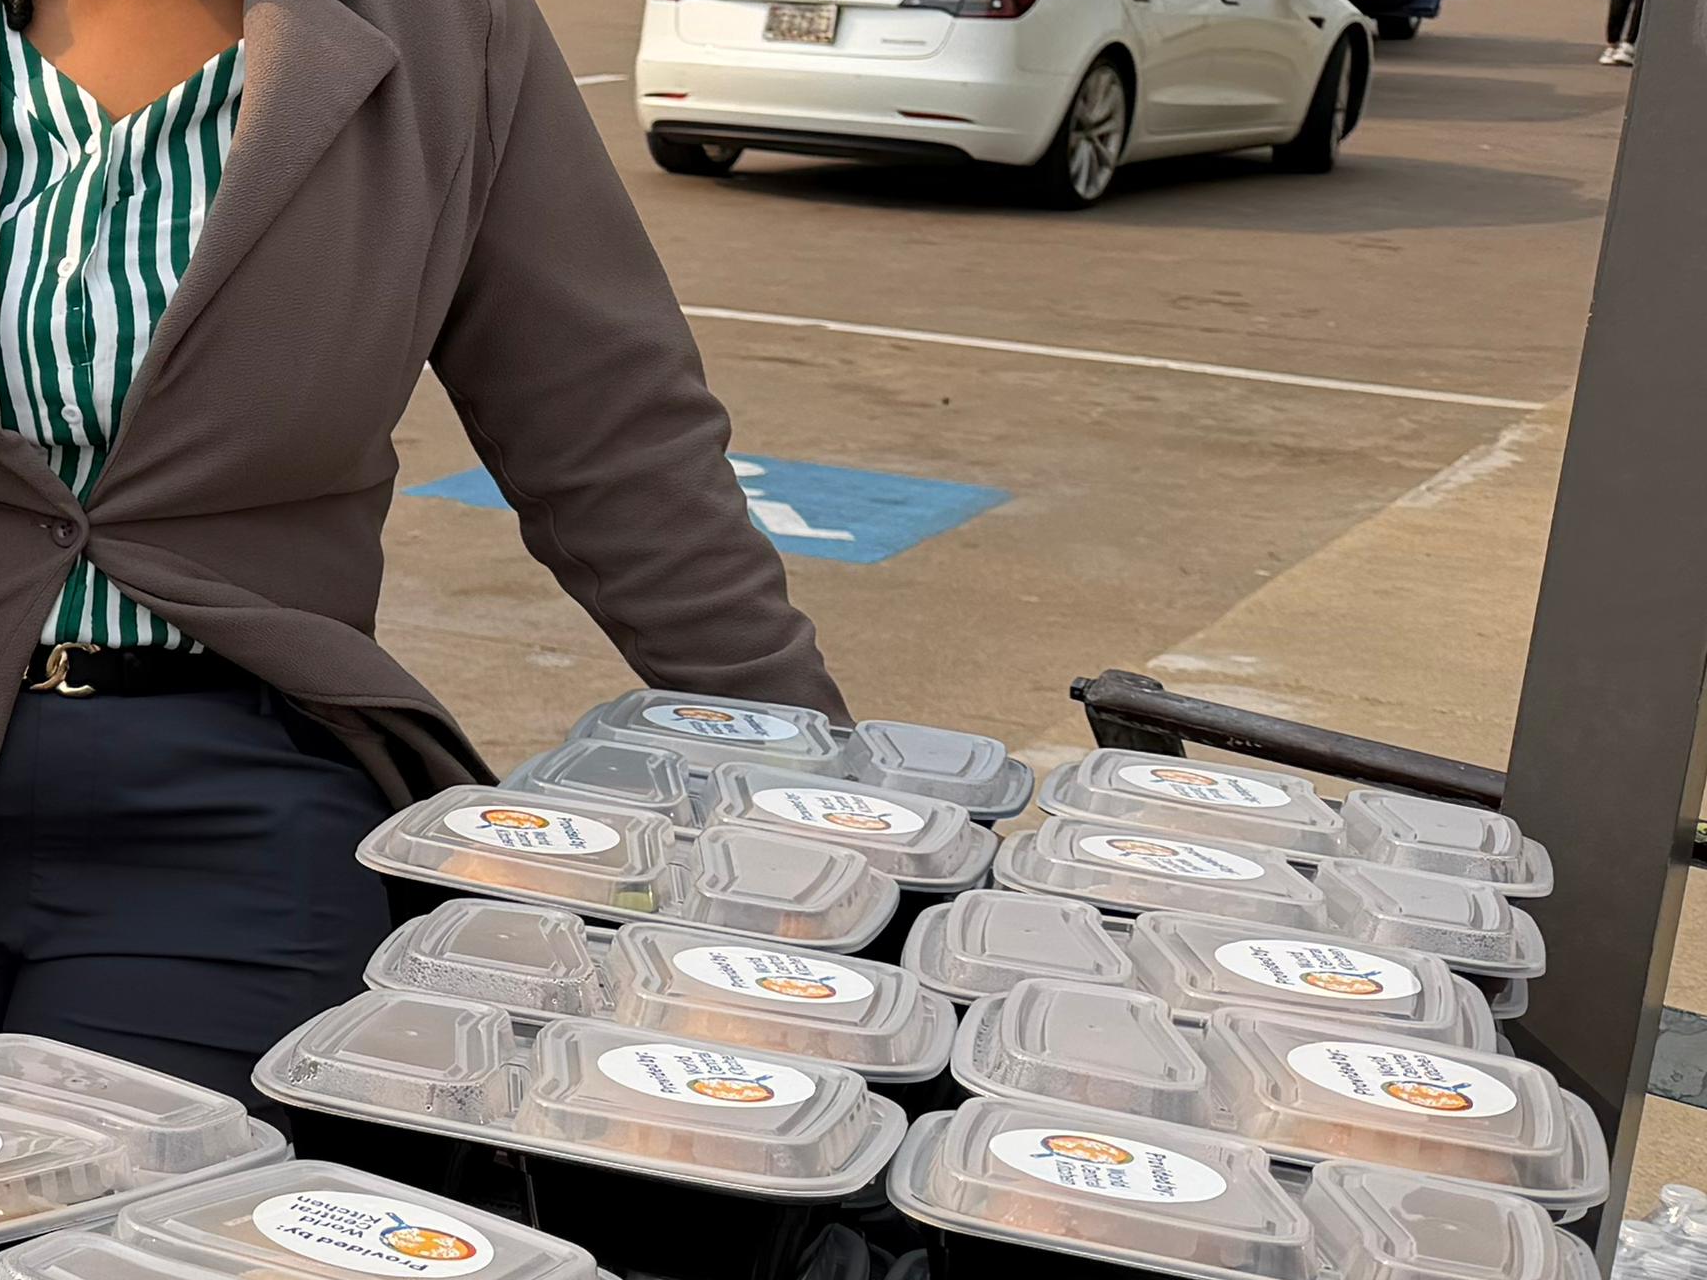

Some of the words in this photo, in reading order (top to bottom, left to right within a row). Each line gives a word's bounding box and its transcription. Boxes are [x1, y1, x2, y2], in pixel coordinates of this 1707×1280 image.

[288, 1203, 372, 1230] Central
[295, 1195, 382, 1224] Kitchen
[275, 1224, 314, 1240] by:
[297, 1214, 363, 1238] World
[314, 1236, 428, 1271] Provided
